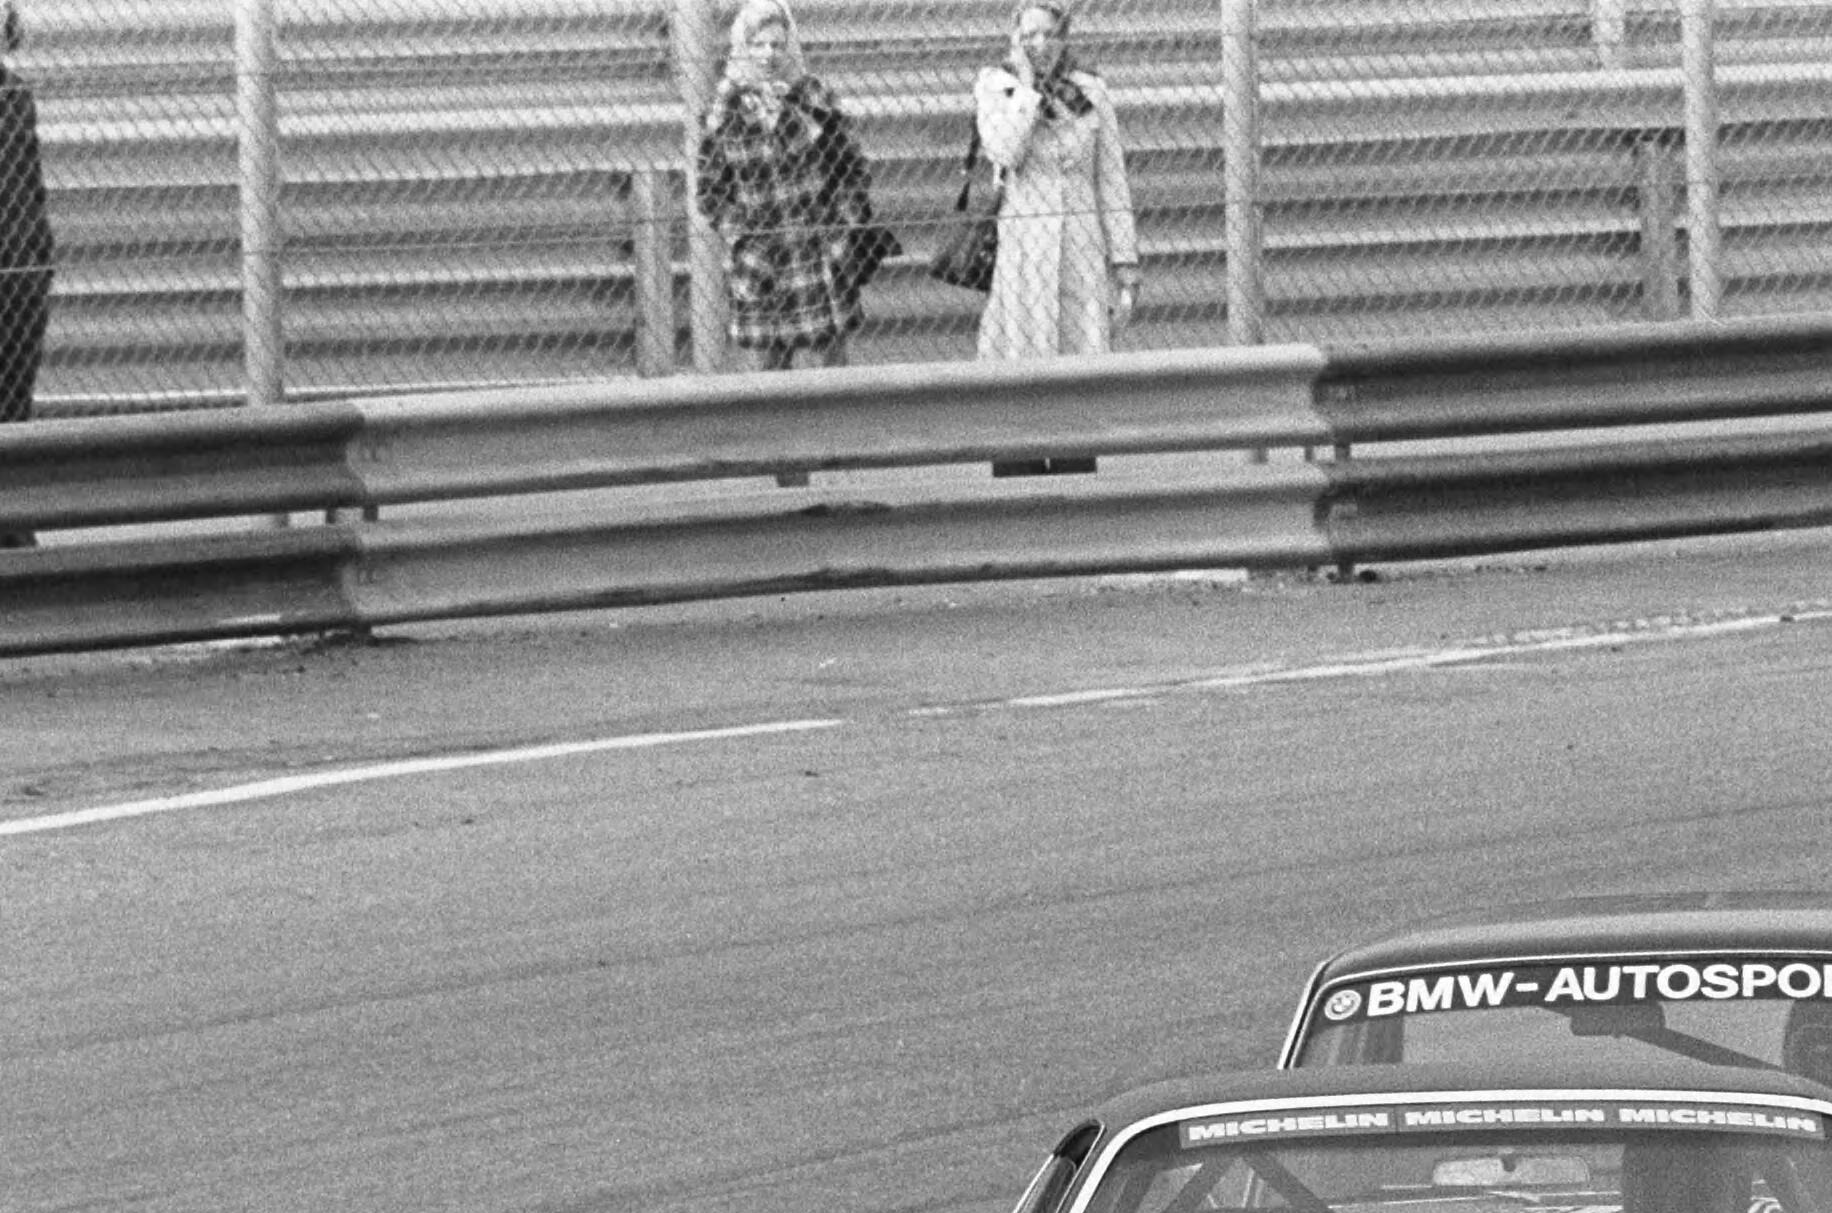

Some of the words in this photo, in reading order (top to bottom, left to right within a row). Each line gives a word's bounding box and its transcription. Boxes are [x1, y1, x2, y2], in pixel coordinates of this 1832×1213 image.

[1188, 1112, 1389, 1141] MICHELIN
[1404, 1107, 1605, 1126] MICHELIN
[1618, 1107, 1818, 1133] MICHELIN
